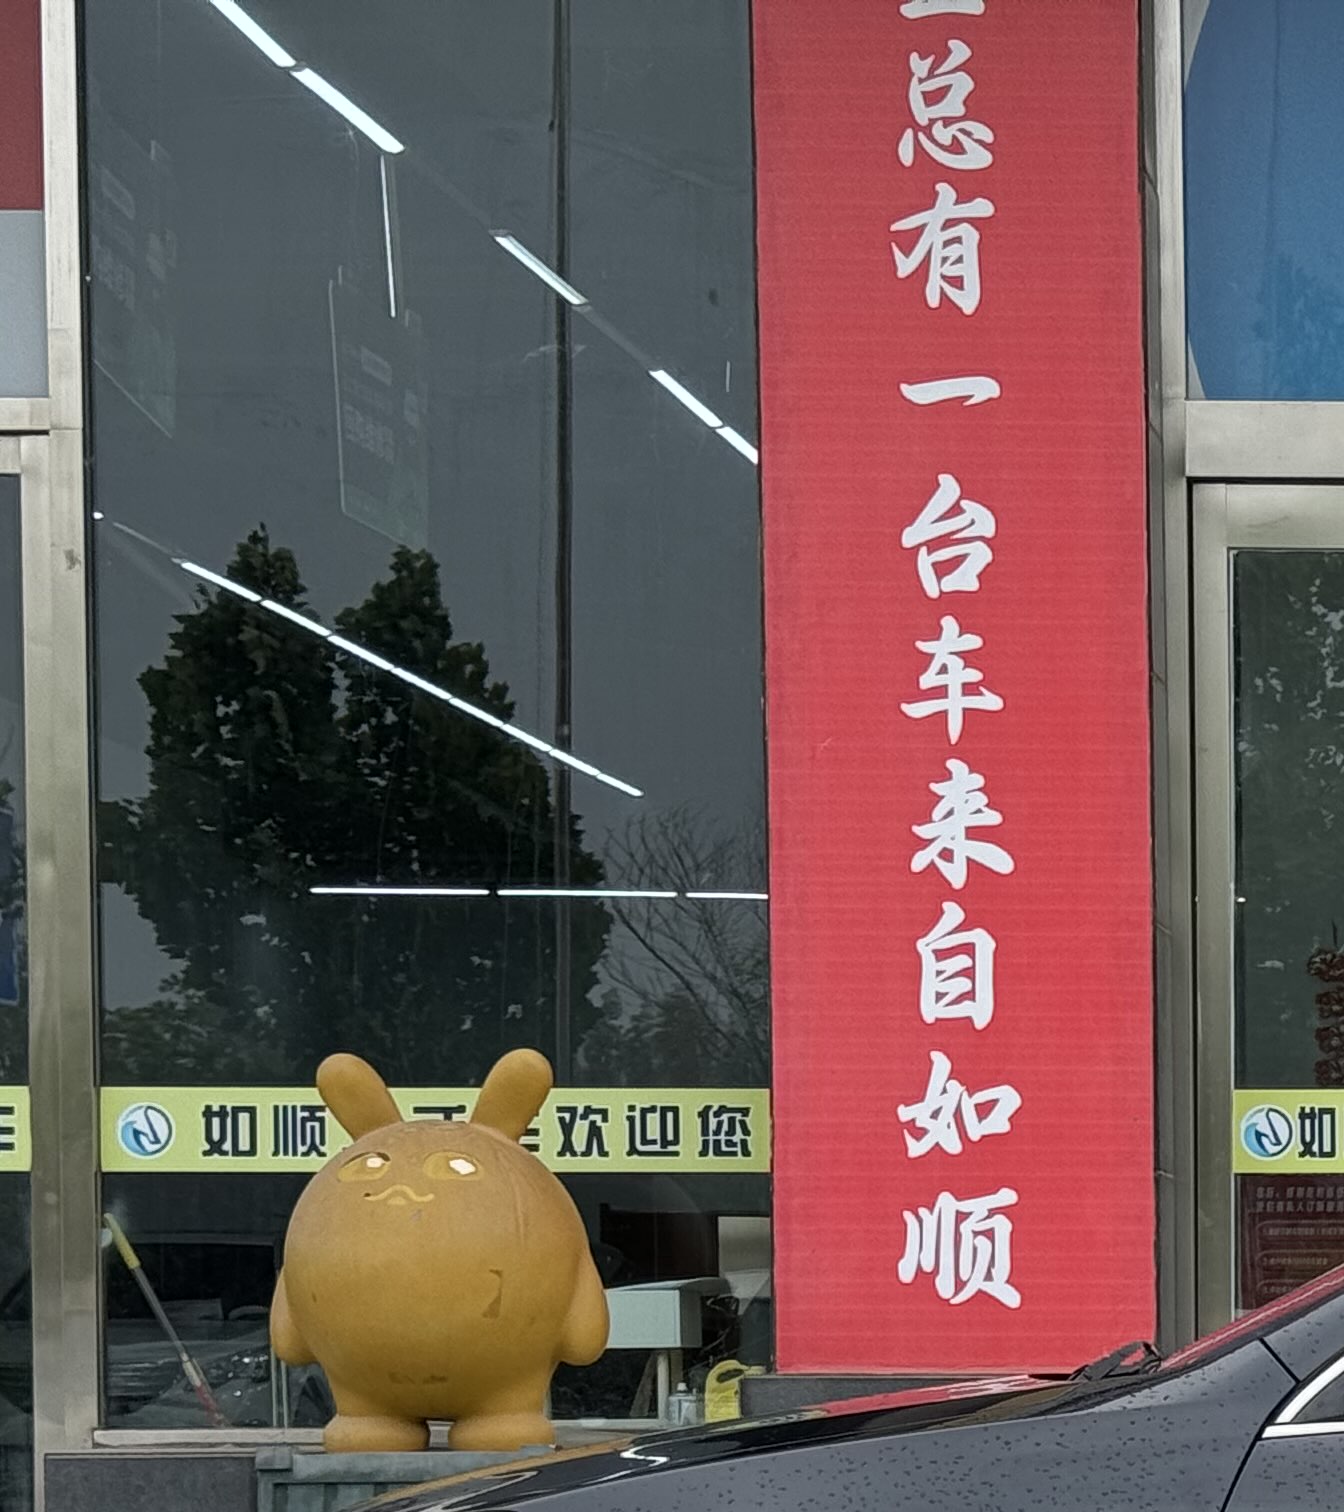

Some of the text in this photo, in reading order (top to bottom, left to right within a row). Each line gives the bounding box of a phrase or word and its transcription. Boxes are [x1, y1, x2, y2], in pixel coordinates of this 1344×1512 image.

[890, 0, 1023, 1310] 总有一台车来自如顺
[201, 1104, 753, 1158] 如顺欢迎您
